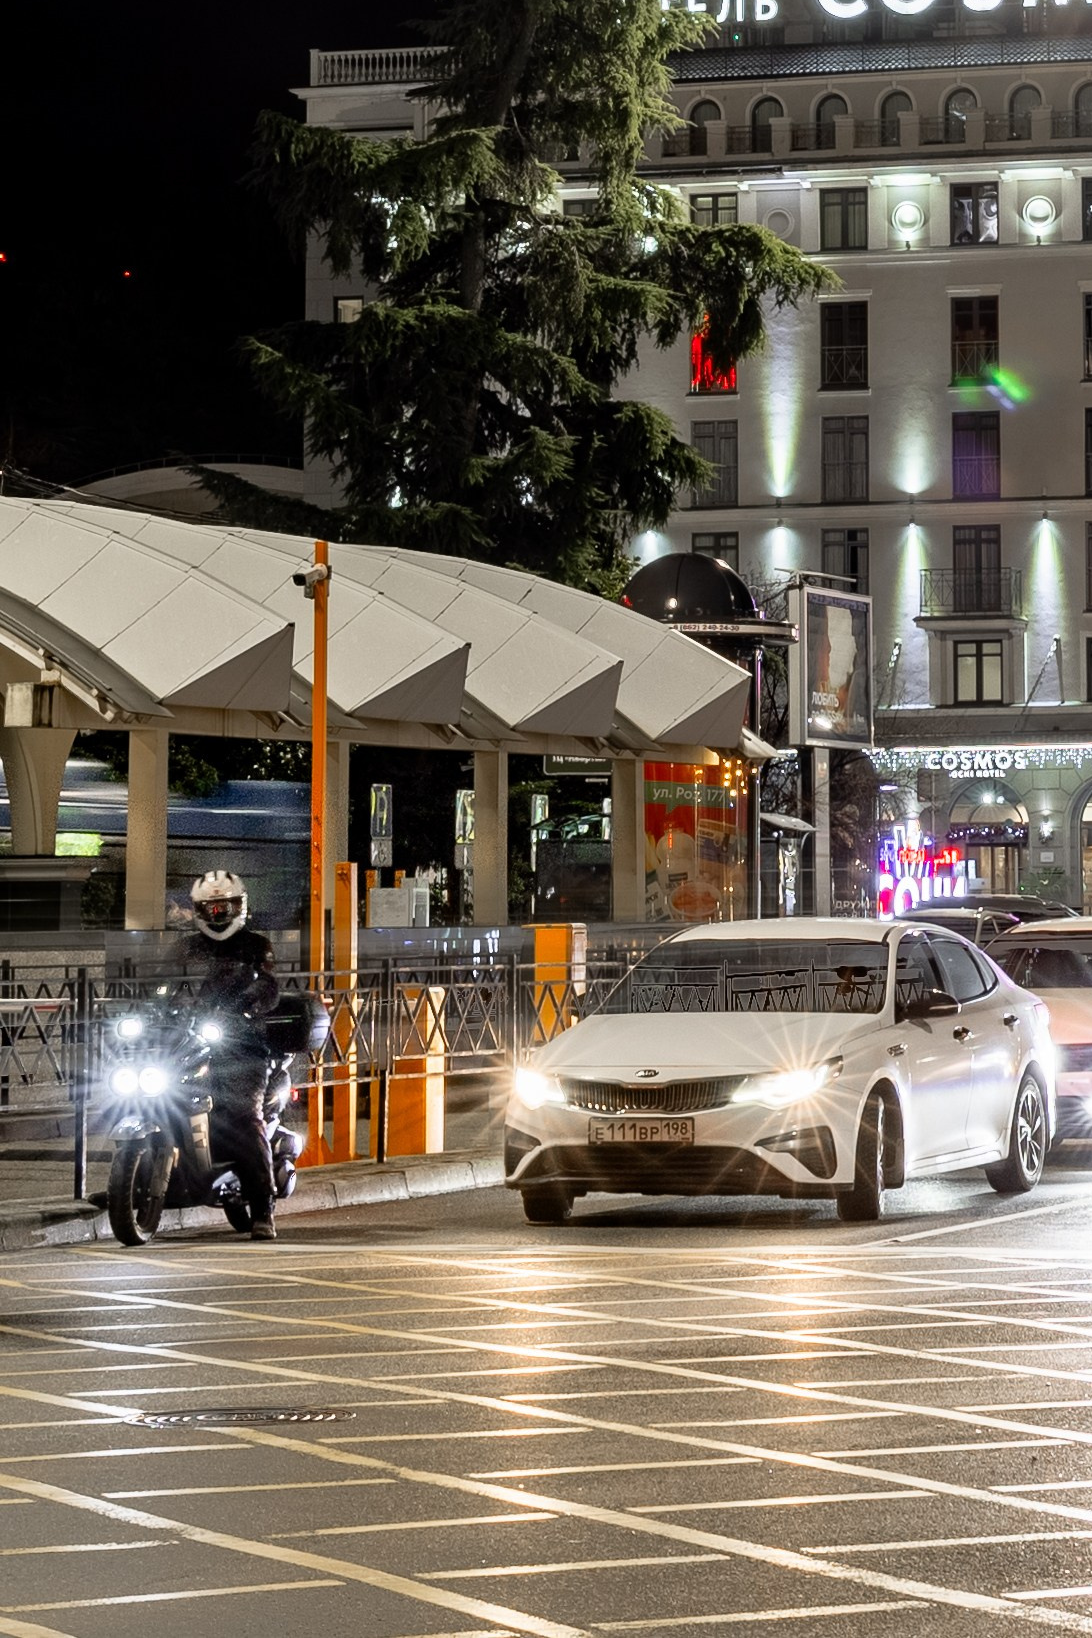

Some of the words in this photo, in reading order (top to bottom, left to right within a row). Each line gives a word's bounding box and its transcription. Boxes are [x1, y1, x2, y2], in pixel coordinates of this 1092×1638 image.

[927, 751, 1026, 770] COSMOS
[976, 769, 1006, 778] HOTEL
[652, 788, 672, 800] ул.
[706, 789, 725, 801] 177
[595, 1123, 660, 1141] Е111ВР
[663, 1122, 688, 1136] 198
